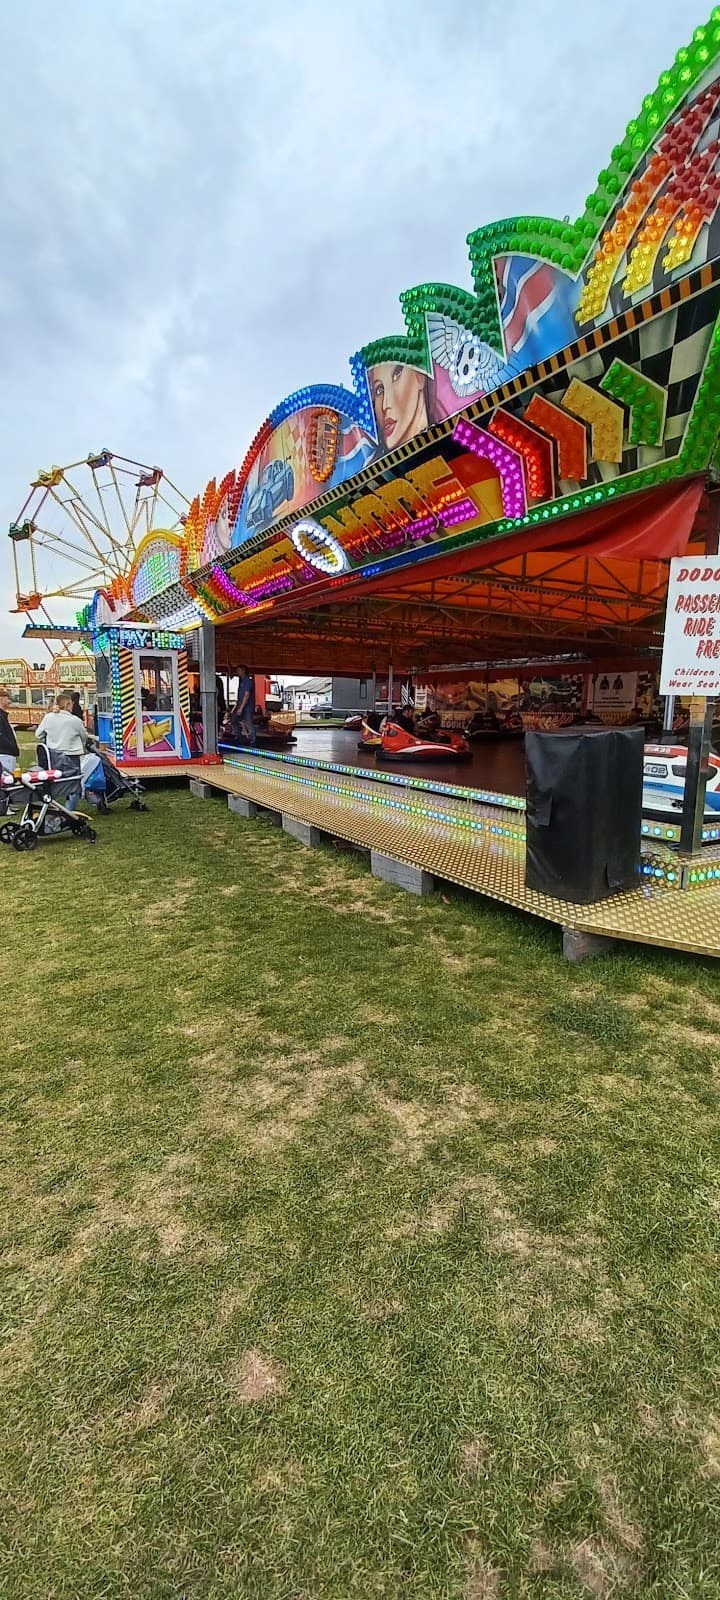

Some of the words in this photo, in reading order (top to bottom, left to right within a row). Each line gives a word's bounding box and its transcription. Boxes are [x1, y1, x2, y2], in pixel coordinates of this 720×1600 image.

[321, 455, 479, 562] MODE
[684, 618, 716, 636] RIDE
[121, 630, 147, 648] PAY
[151, 632, 185, 648] HERE
[696, 640, 720, 658] FRE
[674, 668, 715, 676] Children
[668, 680, 692, 688] Wear
[697, 680, 719, 688] Seat
